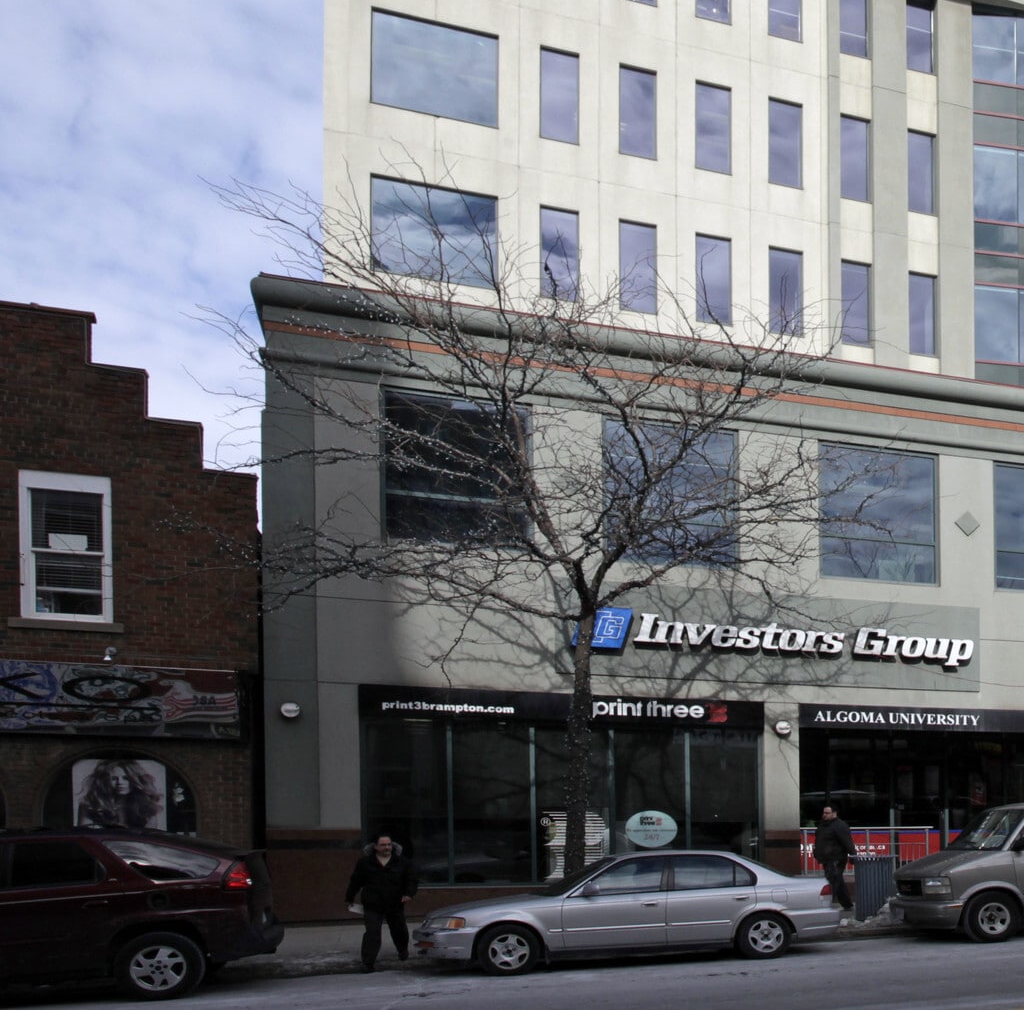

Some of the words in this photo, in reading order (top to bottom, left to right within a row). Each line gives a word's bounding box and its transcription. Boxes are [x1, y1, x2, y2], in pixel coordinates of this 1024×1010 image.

[634, 613, 845, 654] Investors
[853, 626, 974, 667] Group
[382, 701, 515, 714] print3brampton.com
[593, 699, 642, 718] print
[647, 701, 705, 718] three
[814, 710, 886, 724] ALGOMA
[888, 713, 981, 726] UNIVERSITY
